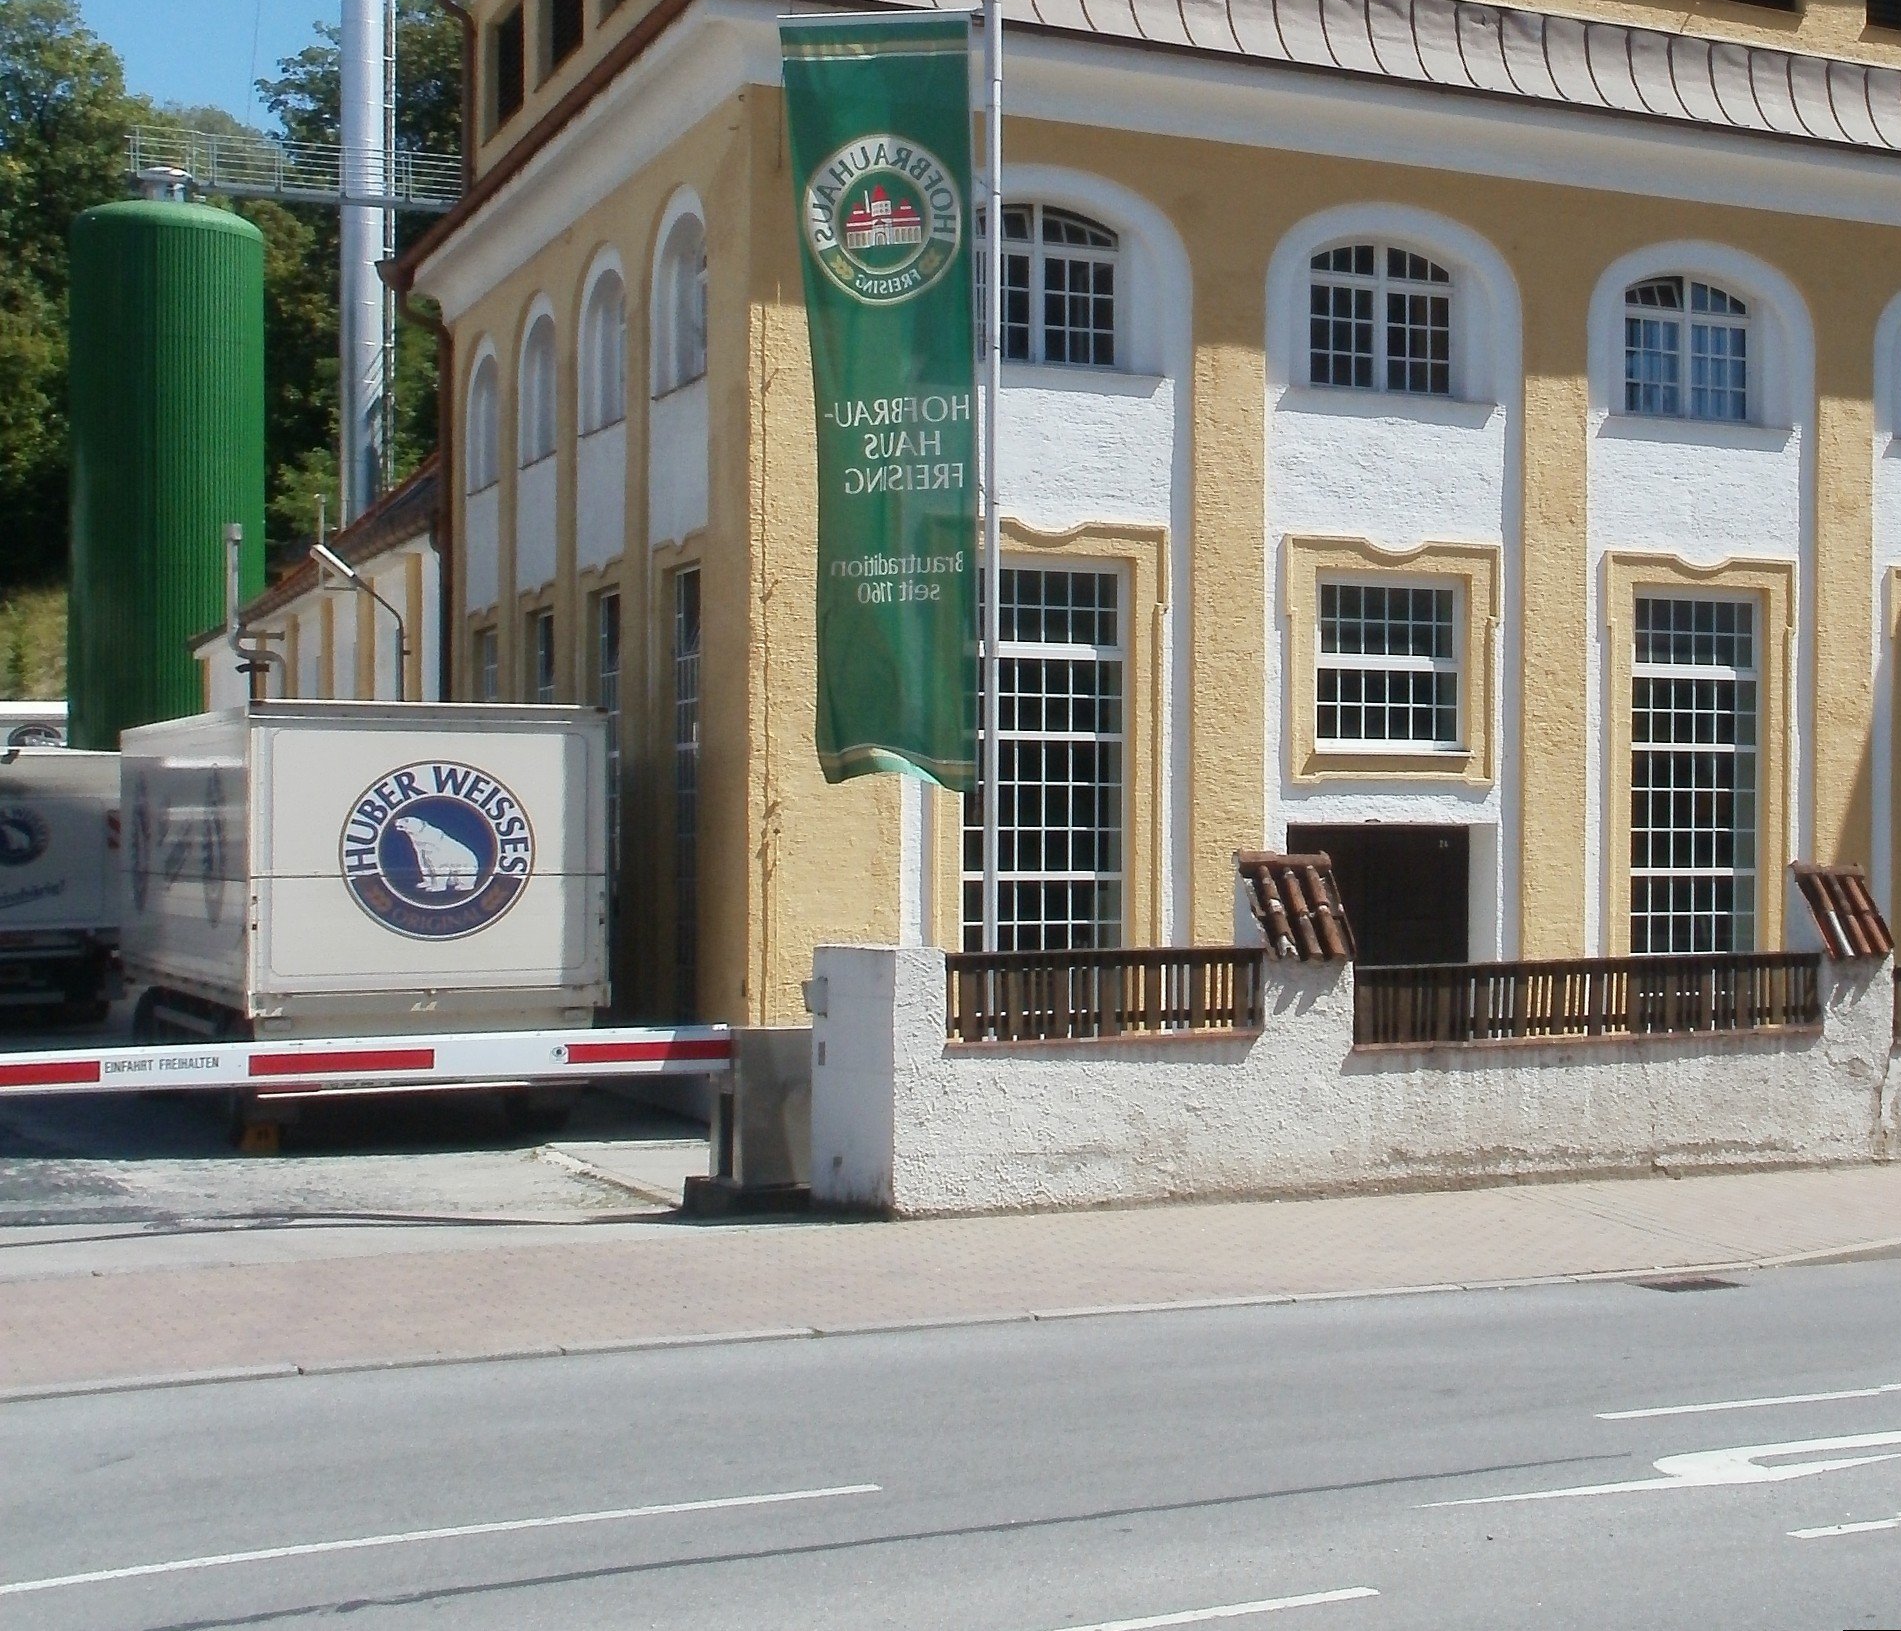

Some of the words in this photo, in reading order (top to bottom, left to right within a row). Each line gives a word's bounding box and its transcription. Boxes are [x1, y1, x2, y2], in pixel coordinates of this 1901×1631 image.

[344, 771, 429, 874] HUBER
[432, 765, 530, 874] WEISSES
[104, 1059, 154, 1074] EINFAHRT
[158, 1056, 220, 1071] FREIHALTEN
